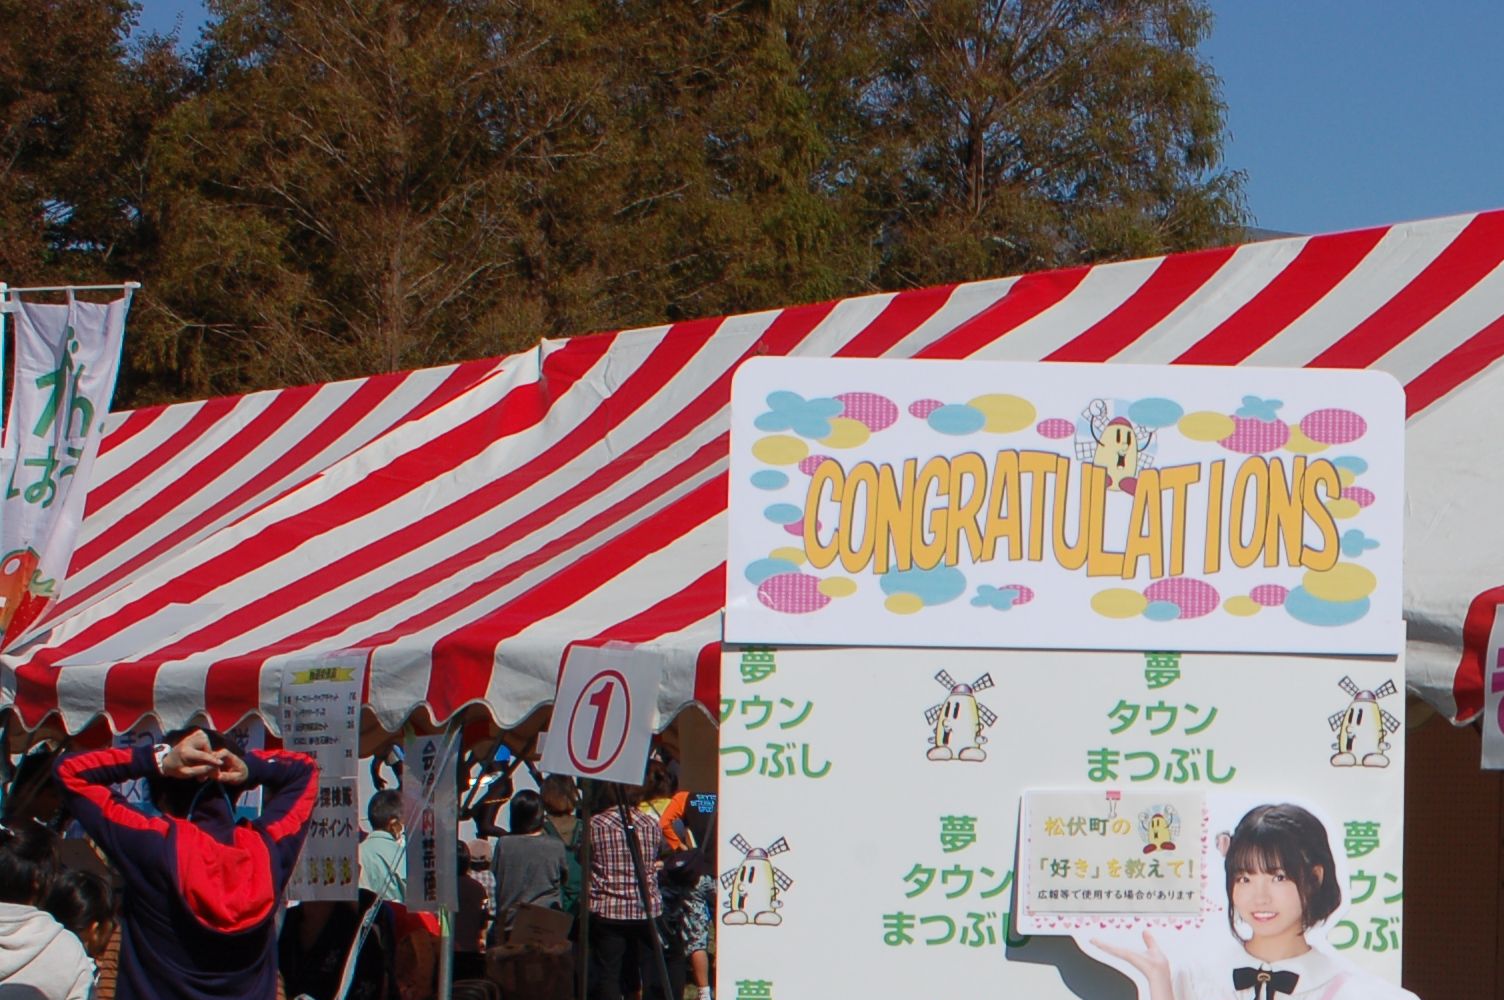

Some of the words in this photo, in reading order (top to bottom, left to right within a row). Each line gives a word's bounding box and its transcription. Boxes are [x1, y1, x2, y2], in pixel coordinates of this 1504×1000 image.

[803, 450, 1341, 579] CONGRATULATIONS
[1108, 700, 1218, 736] タウン
[1087, 747, 1236, 784] まつぶし
[939, 815, 977, 854] 夢
[1044, 816, 1131, 837] 松伏町の
[1344, 821, 1381, 859] 夢
[904, 864, 1013, 900] タウン
[1038, 889, 1195, 900] 広報等で使用する場合があります
